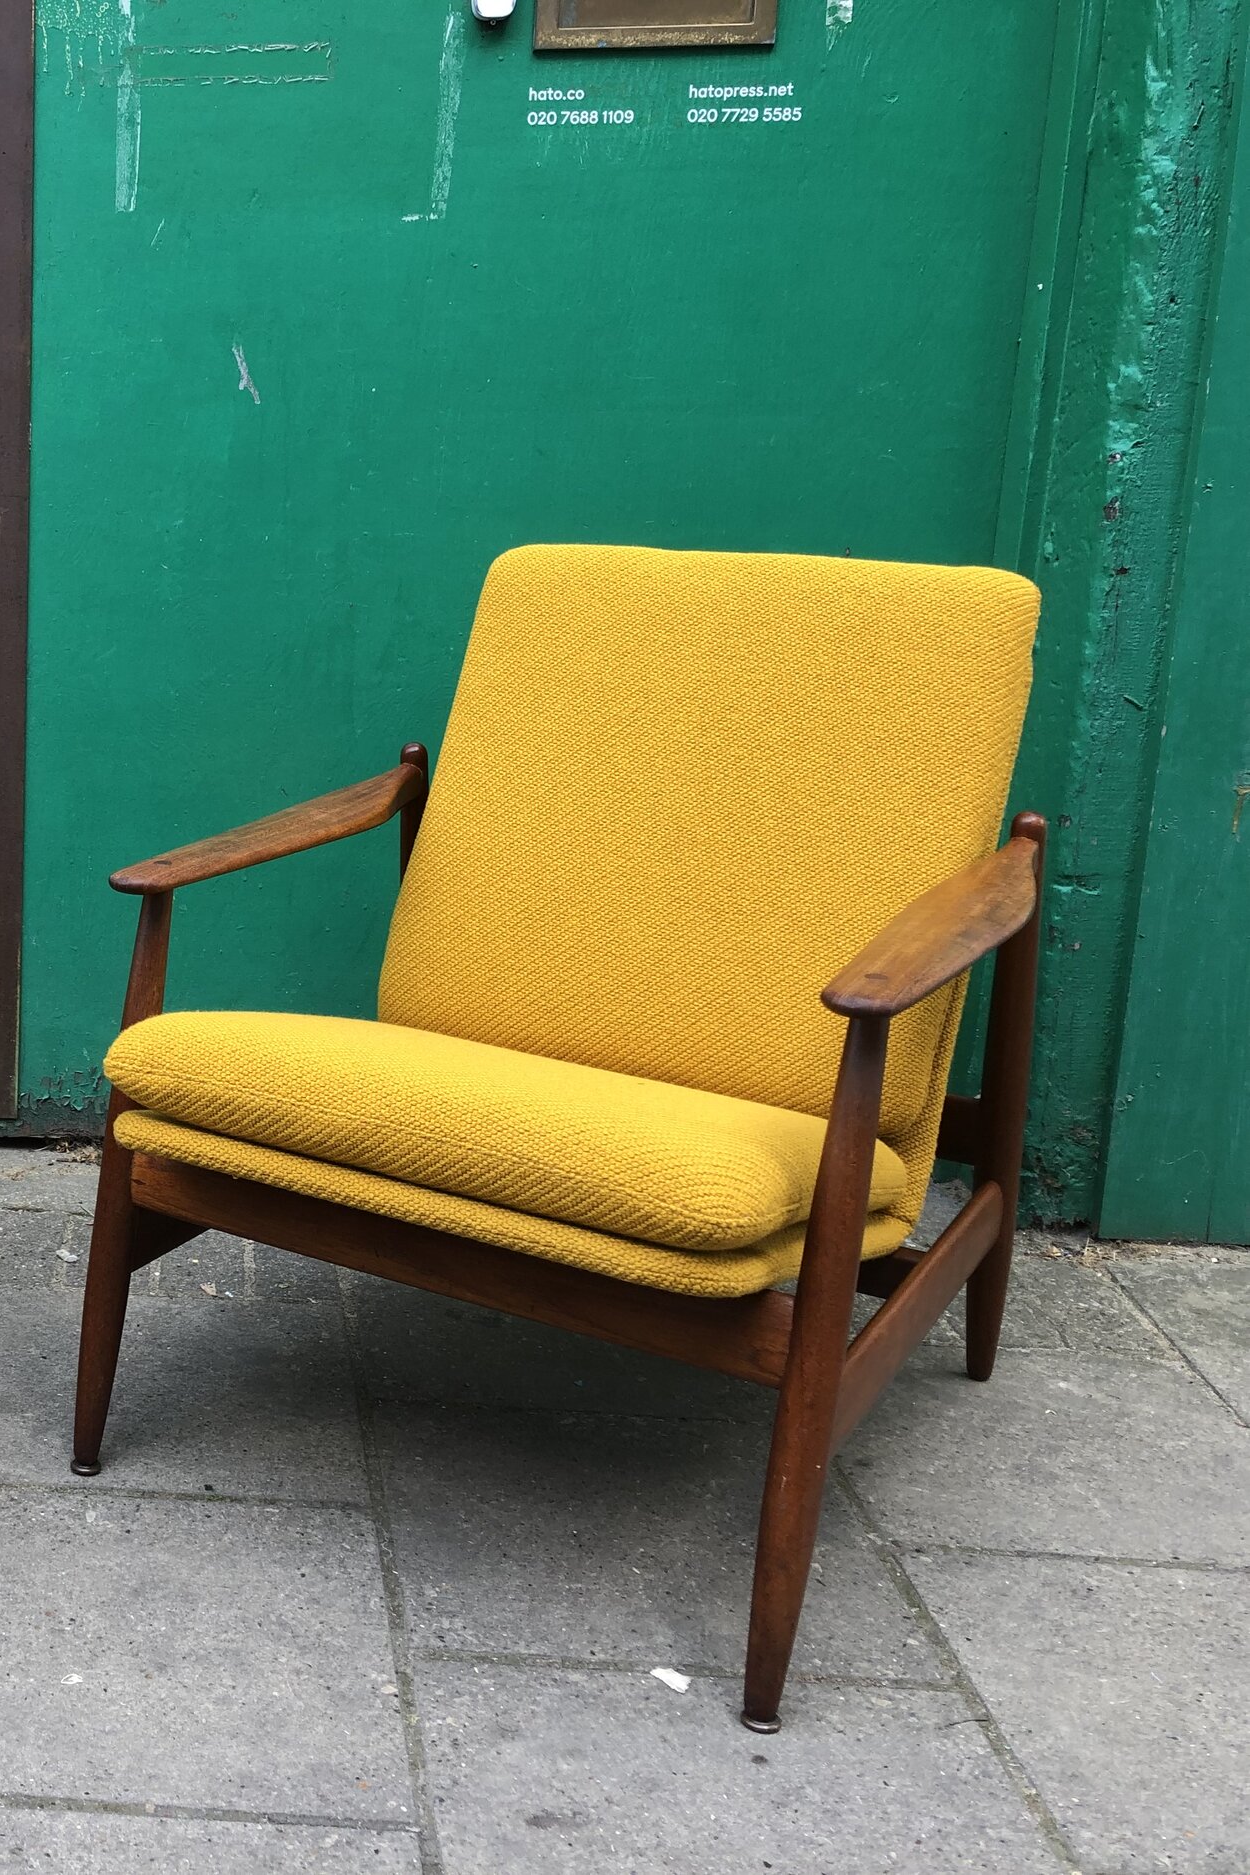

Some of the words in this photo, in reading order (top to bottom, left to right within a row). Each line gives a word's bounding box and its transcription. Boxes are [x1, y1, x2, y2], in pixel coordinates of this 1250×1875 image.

[528, 87, 585, 101] hato.co
[689, 82, 794, 101] hatopress.net
[527, 111, 557, 125] 020
[560, 110, 599, 124] 7688
[602, 110, 634, 124] 1109
[687, 108, 718, 123] 020
[721, 108, 758, 122] 7729
[762, 107, 802, 122] 5585
